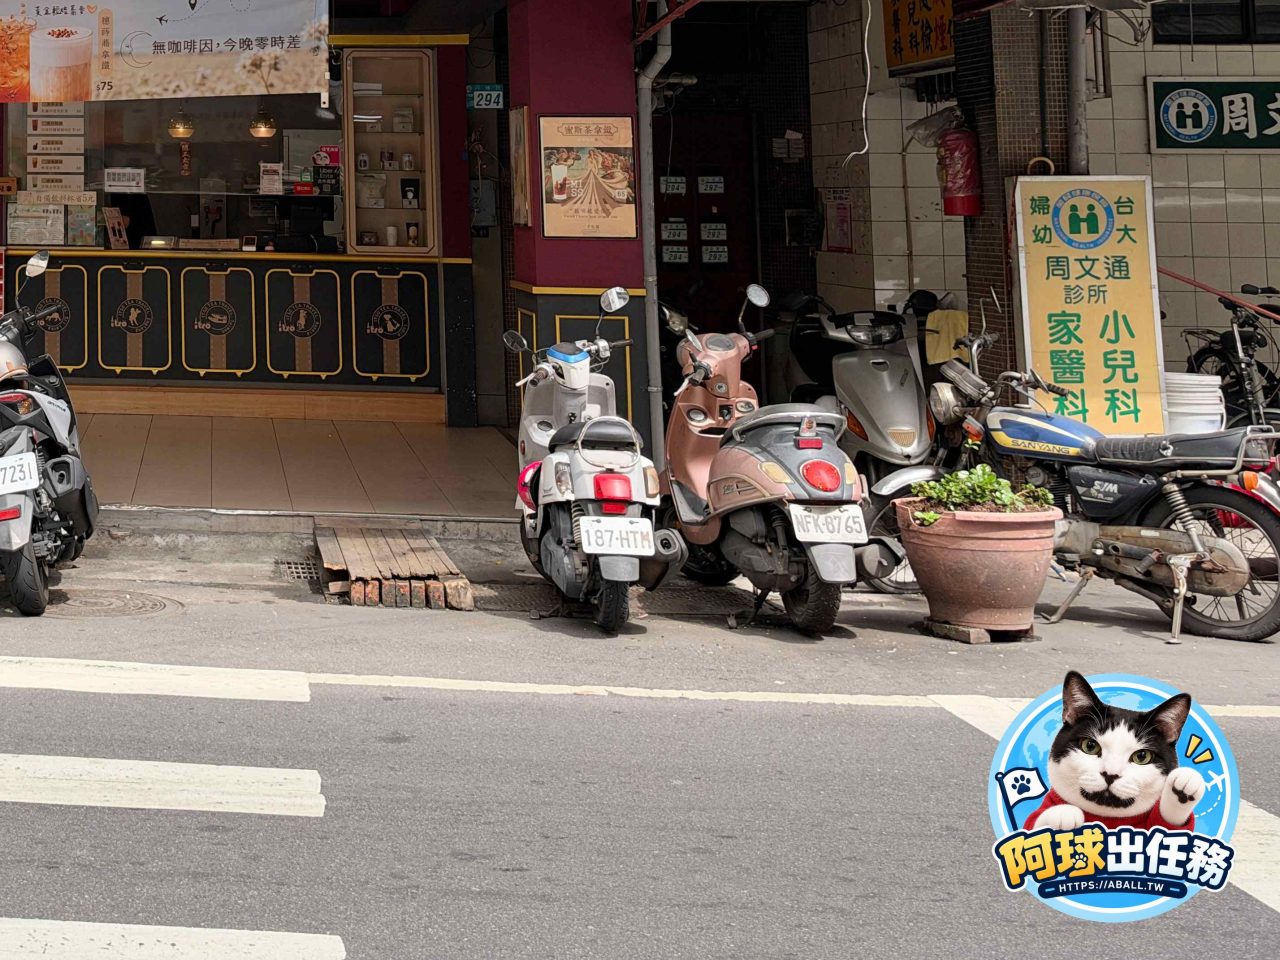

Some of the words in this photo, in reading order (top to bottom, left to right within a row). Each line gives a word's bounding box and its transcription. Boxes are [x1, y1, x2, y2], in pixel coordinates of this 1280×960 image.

[96, 81, 113, 91] $75
[475, 92, 501, 107] 294
[1045, 255, 1131, 281] 周文通
[1063, 284, 1108, 305] 診所
[1047, 310, 1089, 423] 家醫科
[1098, 309, 1141, 423] 小兒科
[1011, 439, 1071, 455] SANYANG
